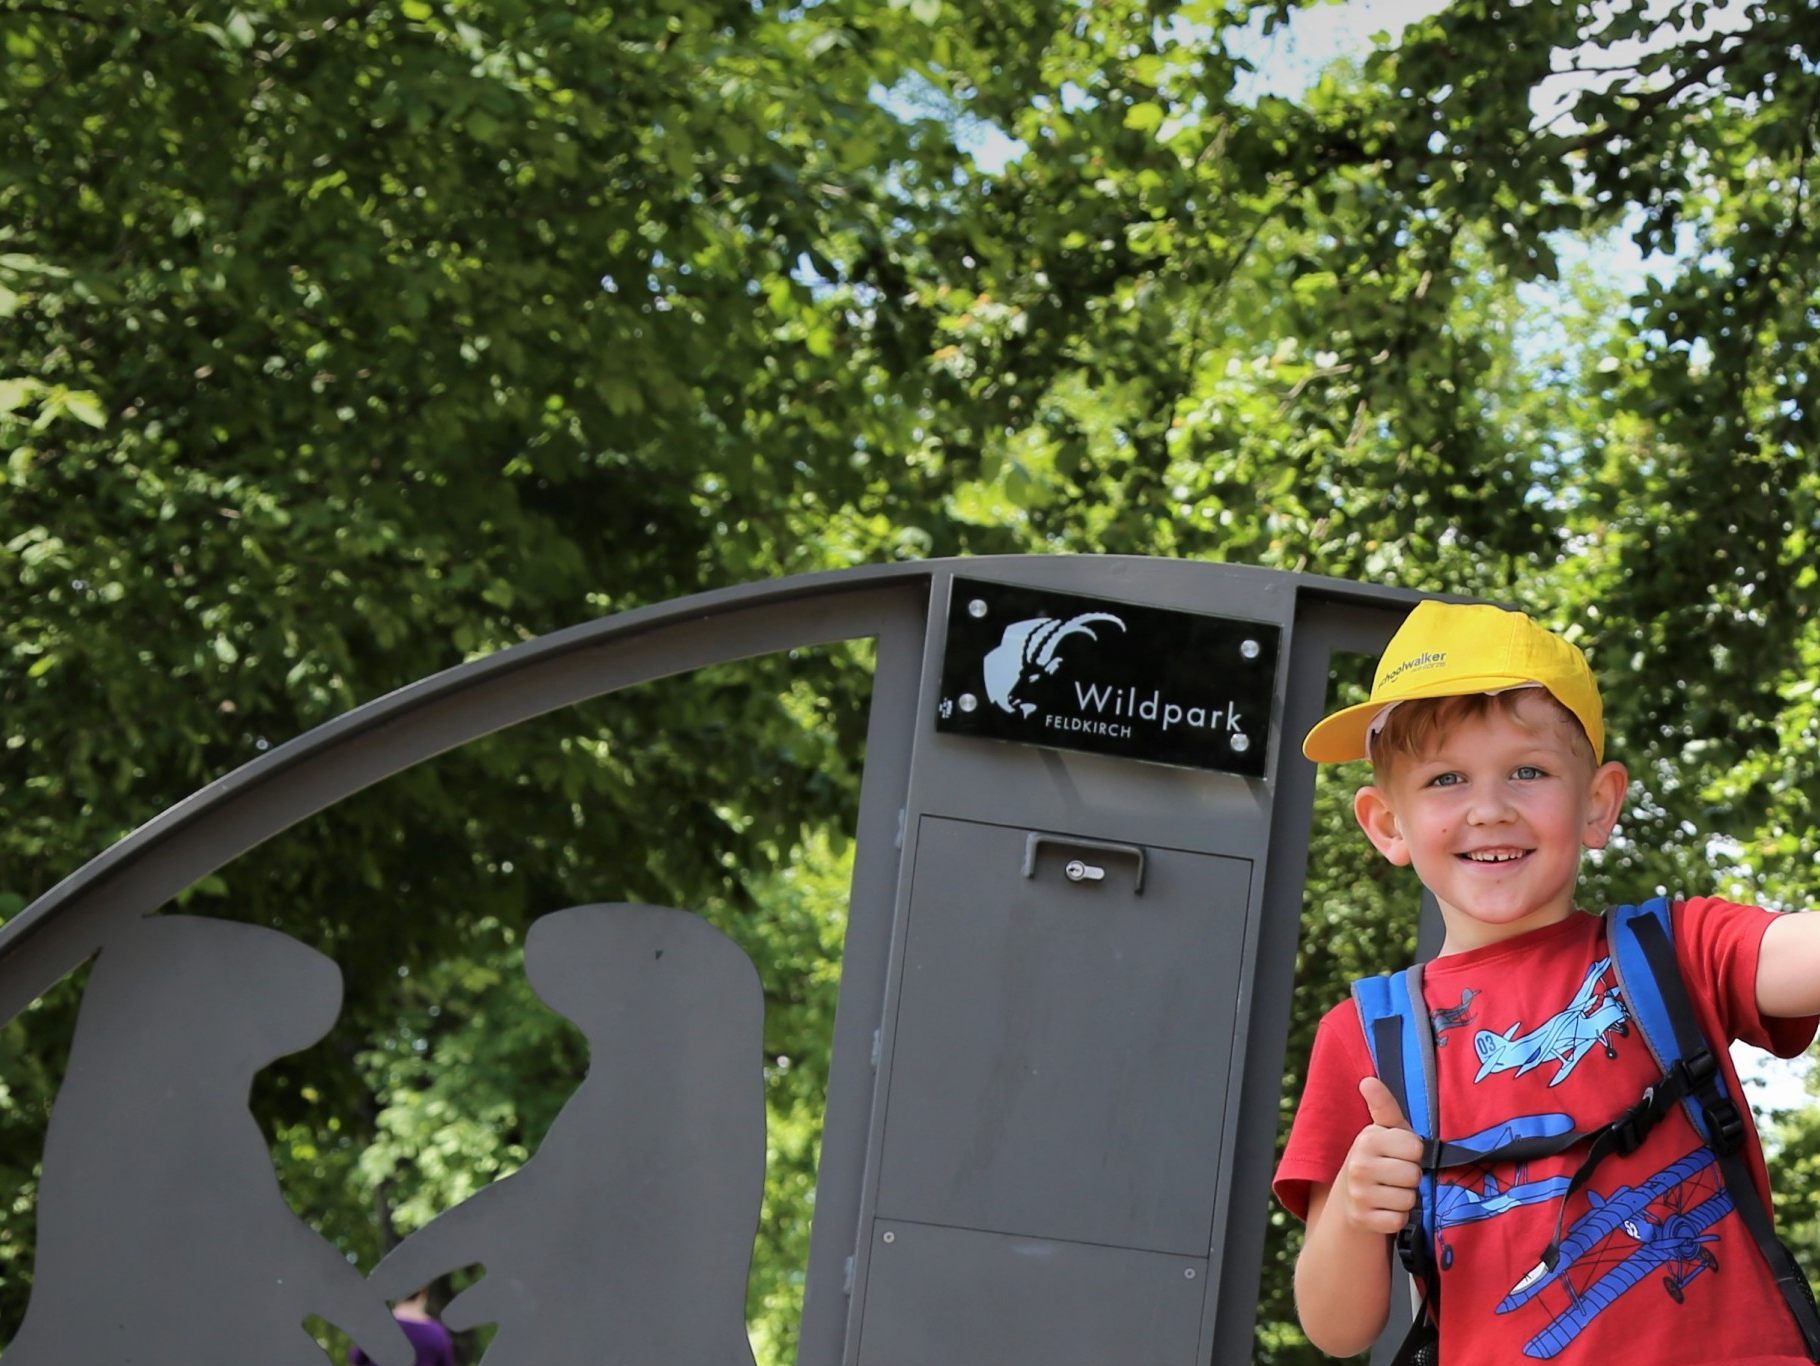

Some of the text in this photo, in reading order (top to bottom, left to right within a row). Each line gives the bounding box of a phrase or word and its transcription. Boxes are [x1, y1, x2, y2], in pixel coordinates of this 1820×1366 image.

[1074, 681, 1244, 733] Wildpark
[1045, 715, 1132, 739] FELDKIRCH
[1477, 1035, 1496, 1055] 03
